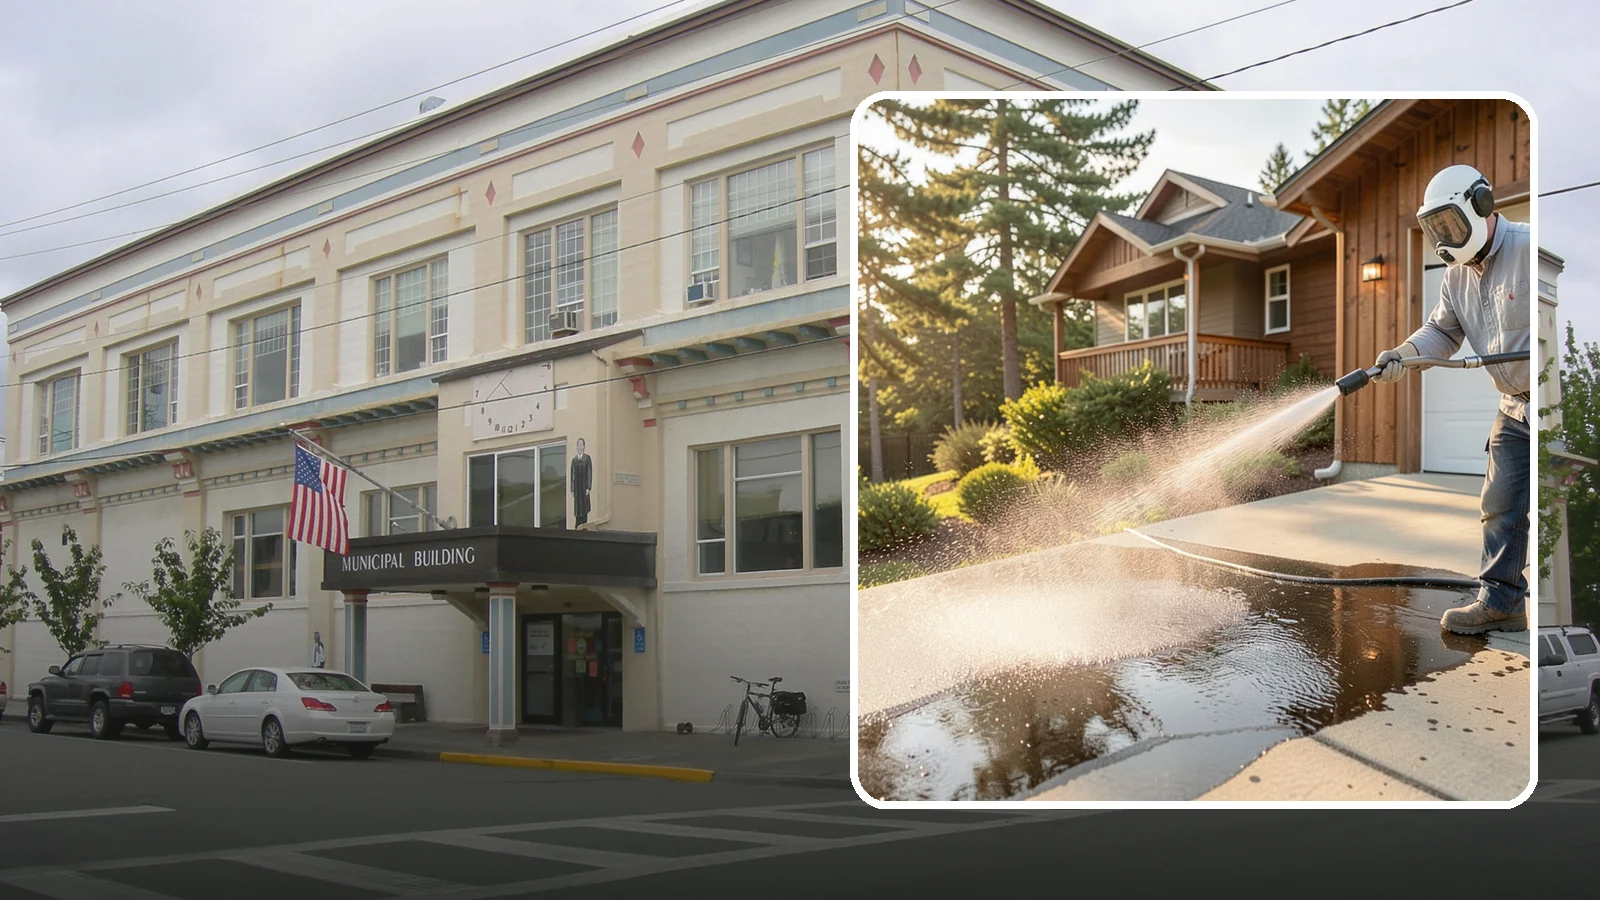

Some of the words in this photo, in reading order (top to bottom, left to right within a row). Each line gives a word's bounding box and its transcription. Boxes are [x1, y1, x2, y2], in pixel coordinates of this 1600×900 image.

[547, 362, 551, 370] 6
[475, 390, 479, 398] 7
[536, 402, 540, 410] 4
[481, 407, 485, 415] 8
[488, 418, 492, 426] 9
[529, 414, 533, 422] 3
[495, 424, 500, 432] 10
[521, 420, 525, 428] 2
[501, 426, 506, 434] 11
[508, 425, 513, 433] 12
[341, 552, 405, 572] MUNICIPAL
[414, 546, 475, 567] BUILDING
